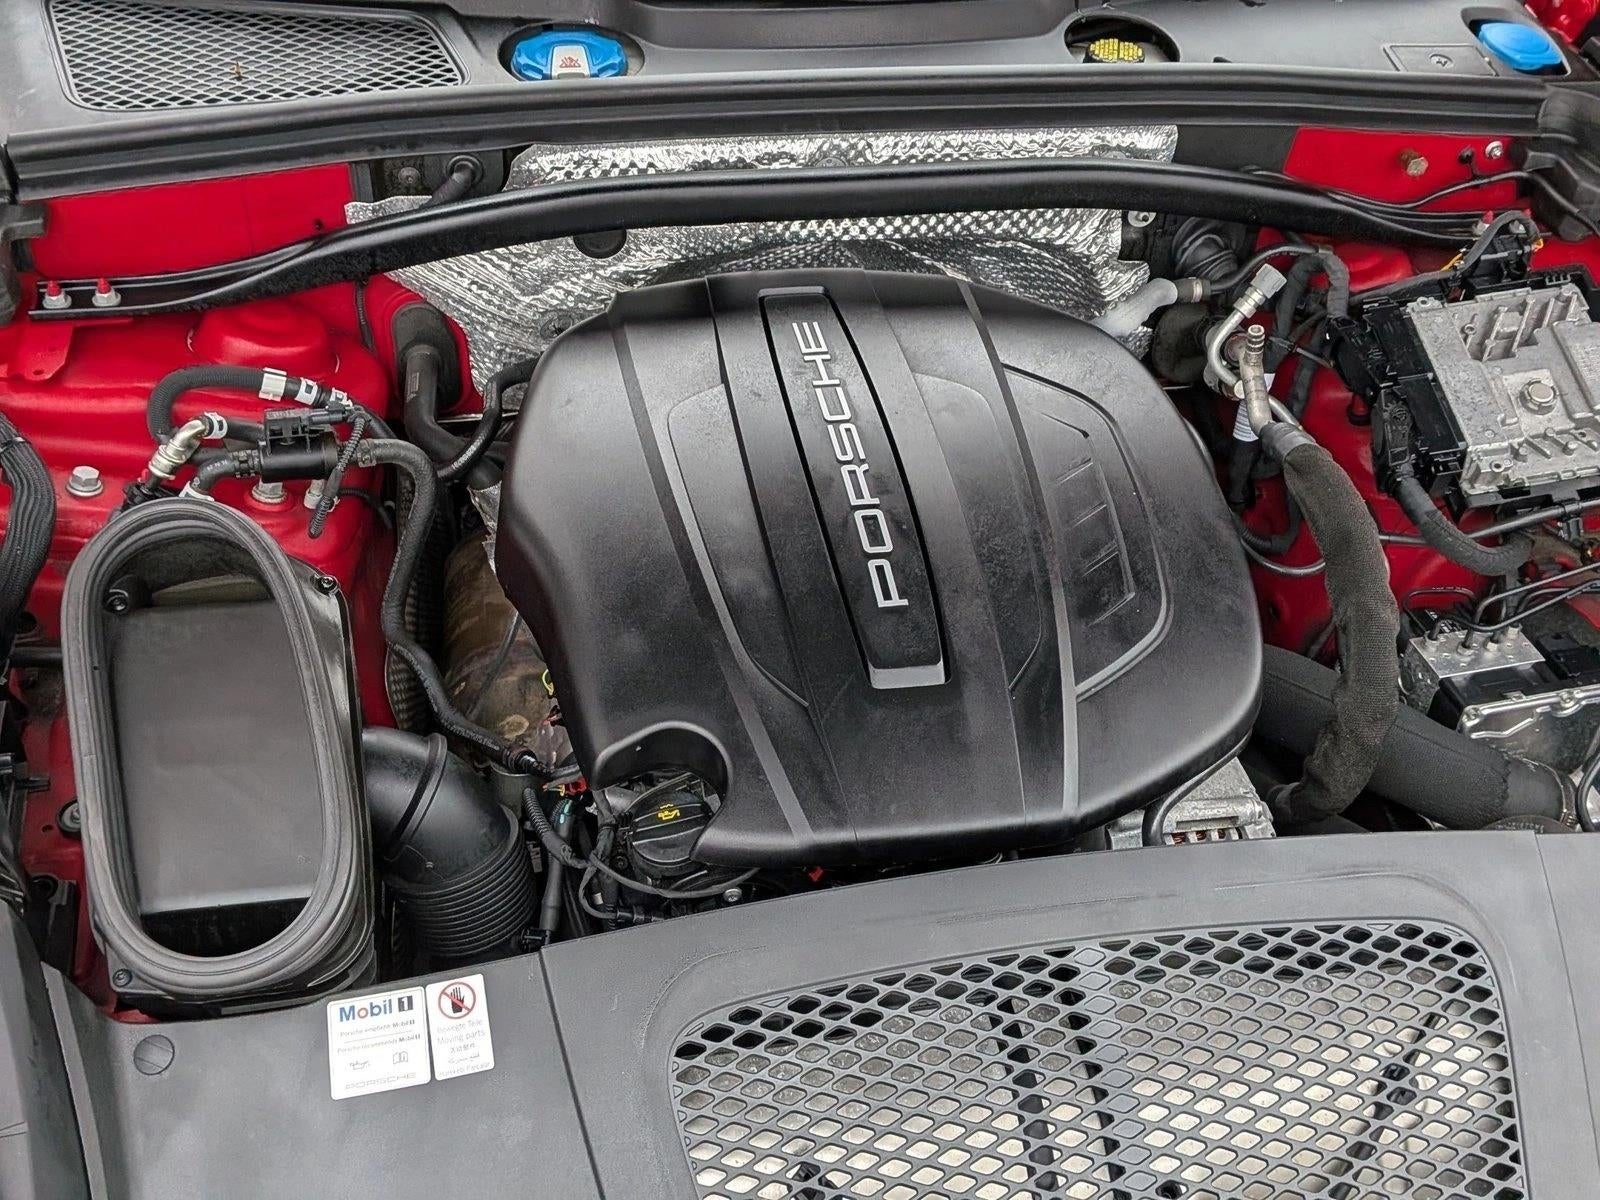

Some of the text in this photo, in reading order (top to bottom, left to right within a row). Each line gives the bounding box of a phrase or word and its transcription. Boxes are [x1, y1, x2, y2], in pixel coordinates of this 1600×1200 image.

[791, 321, 909, 608] PORSCHE
[339, 995, 414, 1022] Mobil 1
[437, 1029, 486, 1046] Moving parts
[345, 1072, 417, 1090] PORSCHE
